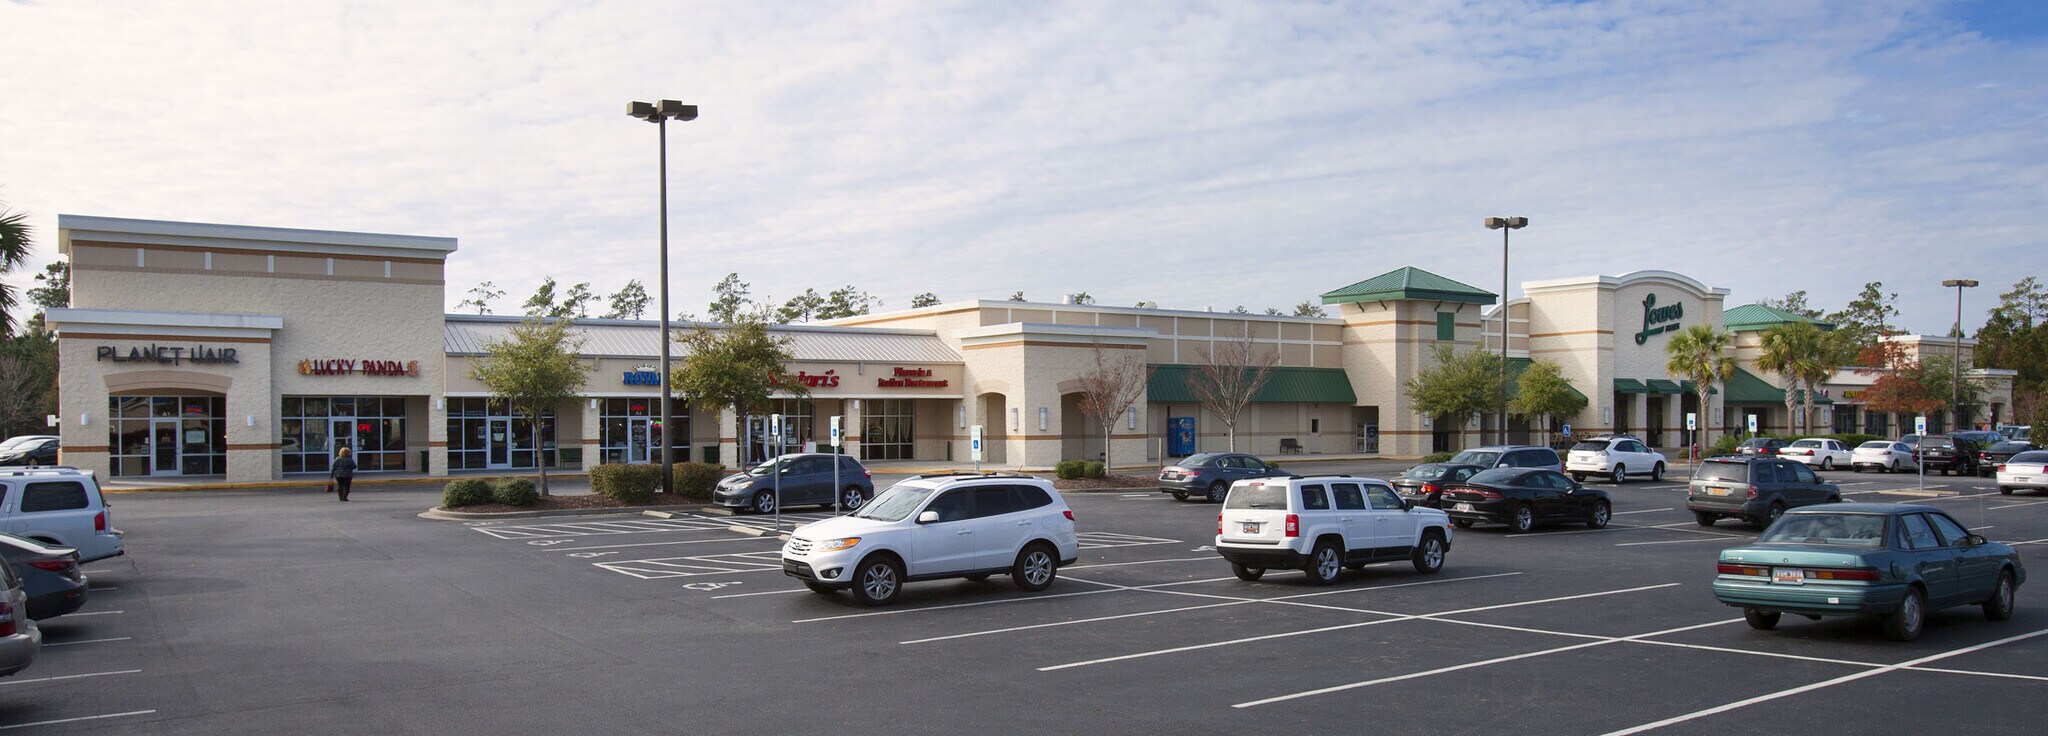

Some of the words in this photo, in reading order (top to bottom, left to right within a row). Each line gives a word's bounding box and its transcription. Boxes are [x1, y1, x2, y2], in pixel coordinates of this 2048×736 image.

[97, 343, 184, 366] PLANET
[190, 345, 240, 363] HAIR
[314, 359, 356, 375] LUCKY
[362, 360, 404, 376] PANDA
[623, 371, 662, 385] ROYA
